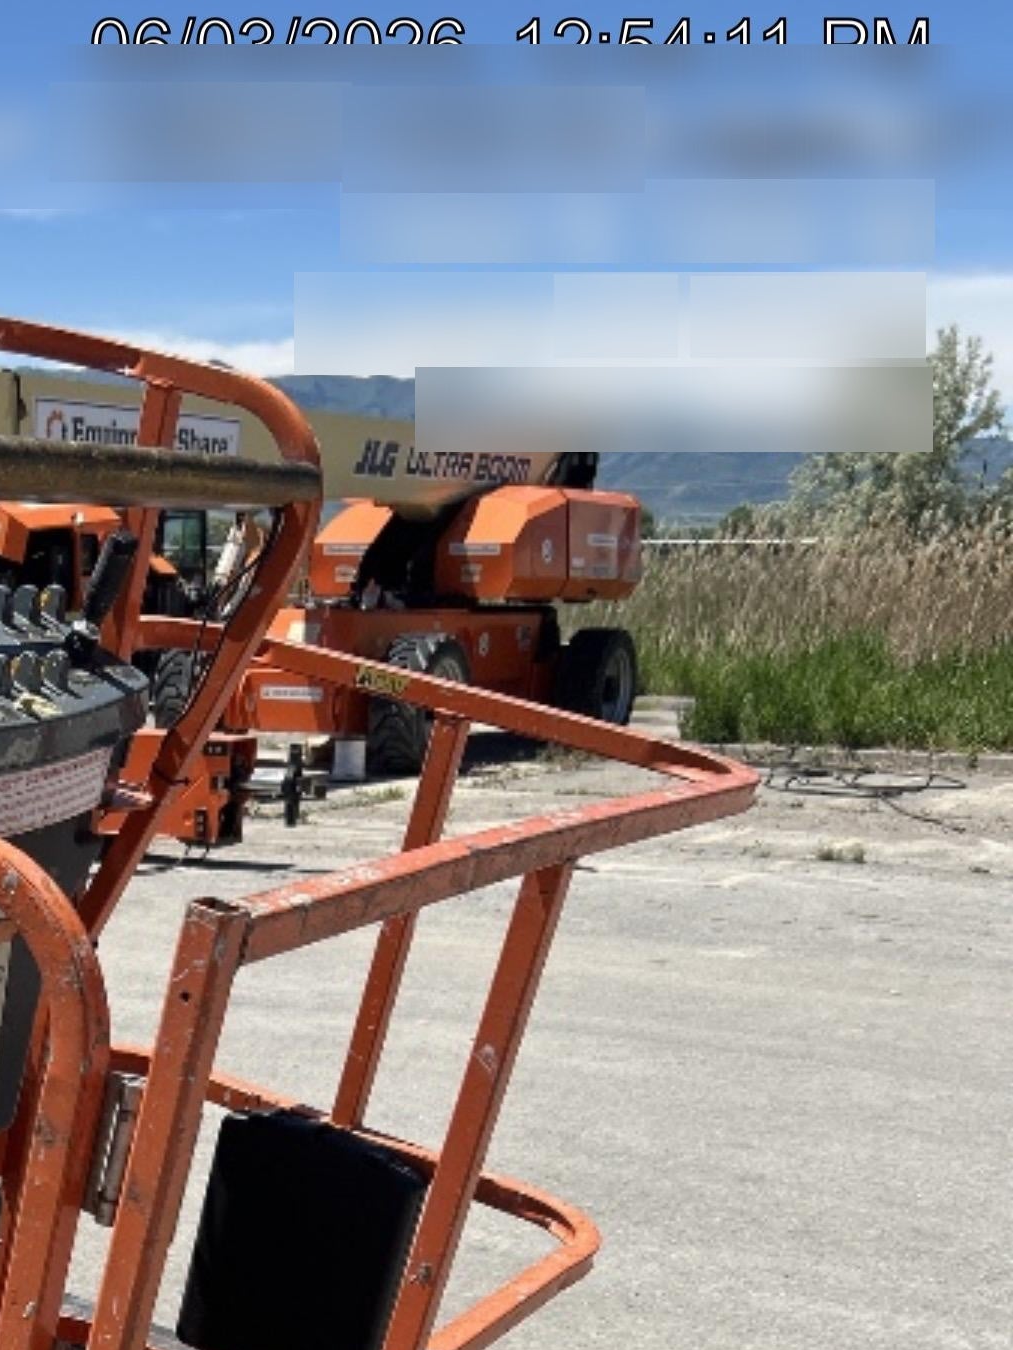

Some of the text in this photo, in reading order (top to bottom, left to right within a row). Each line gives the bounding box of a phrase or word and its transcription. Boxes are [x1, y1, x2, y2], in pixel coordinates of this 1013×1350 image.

[354, 438, 531, 483] JLG ULTRA BOOM
